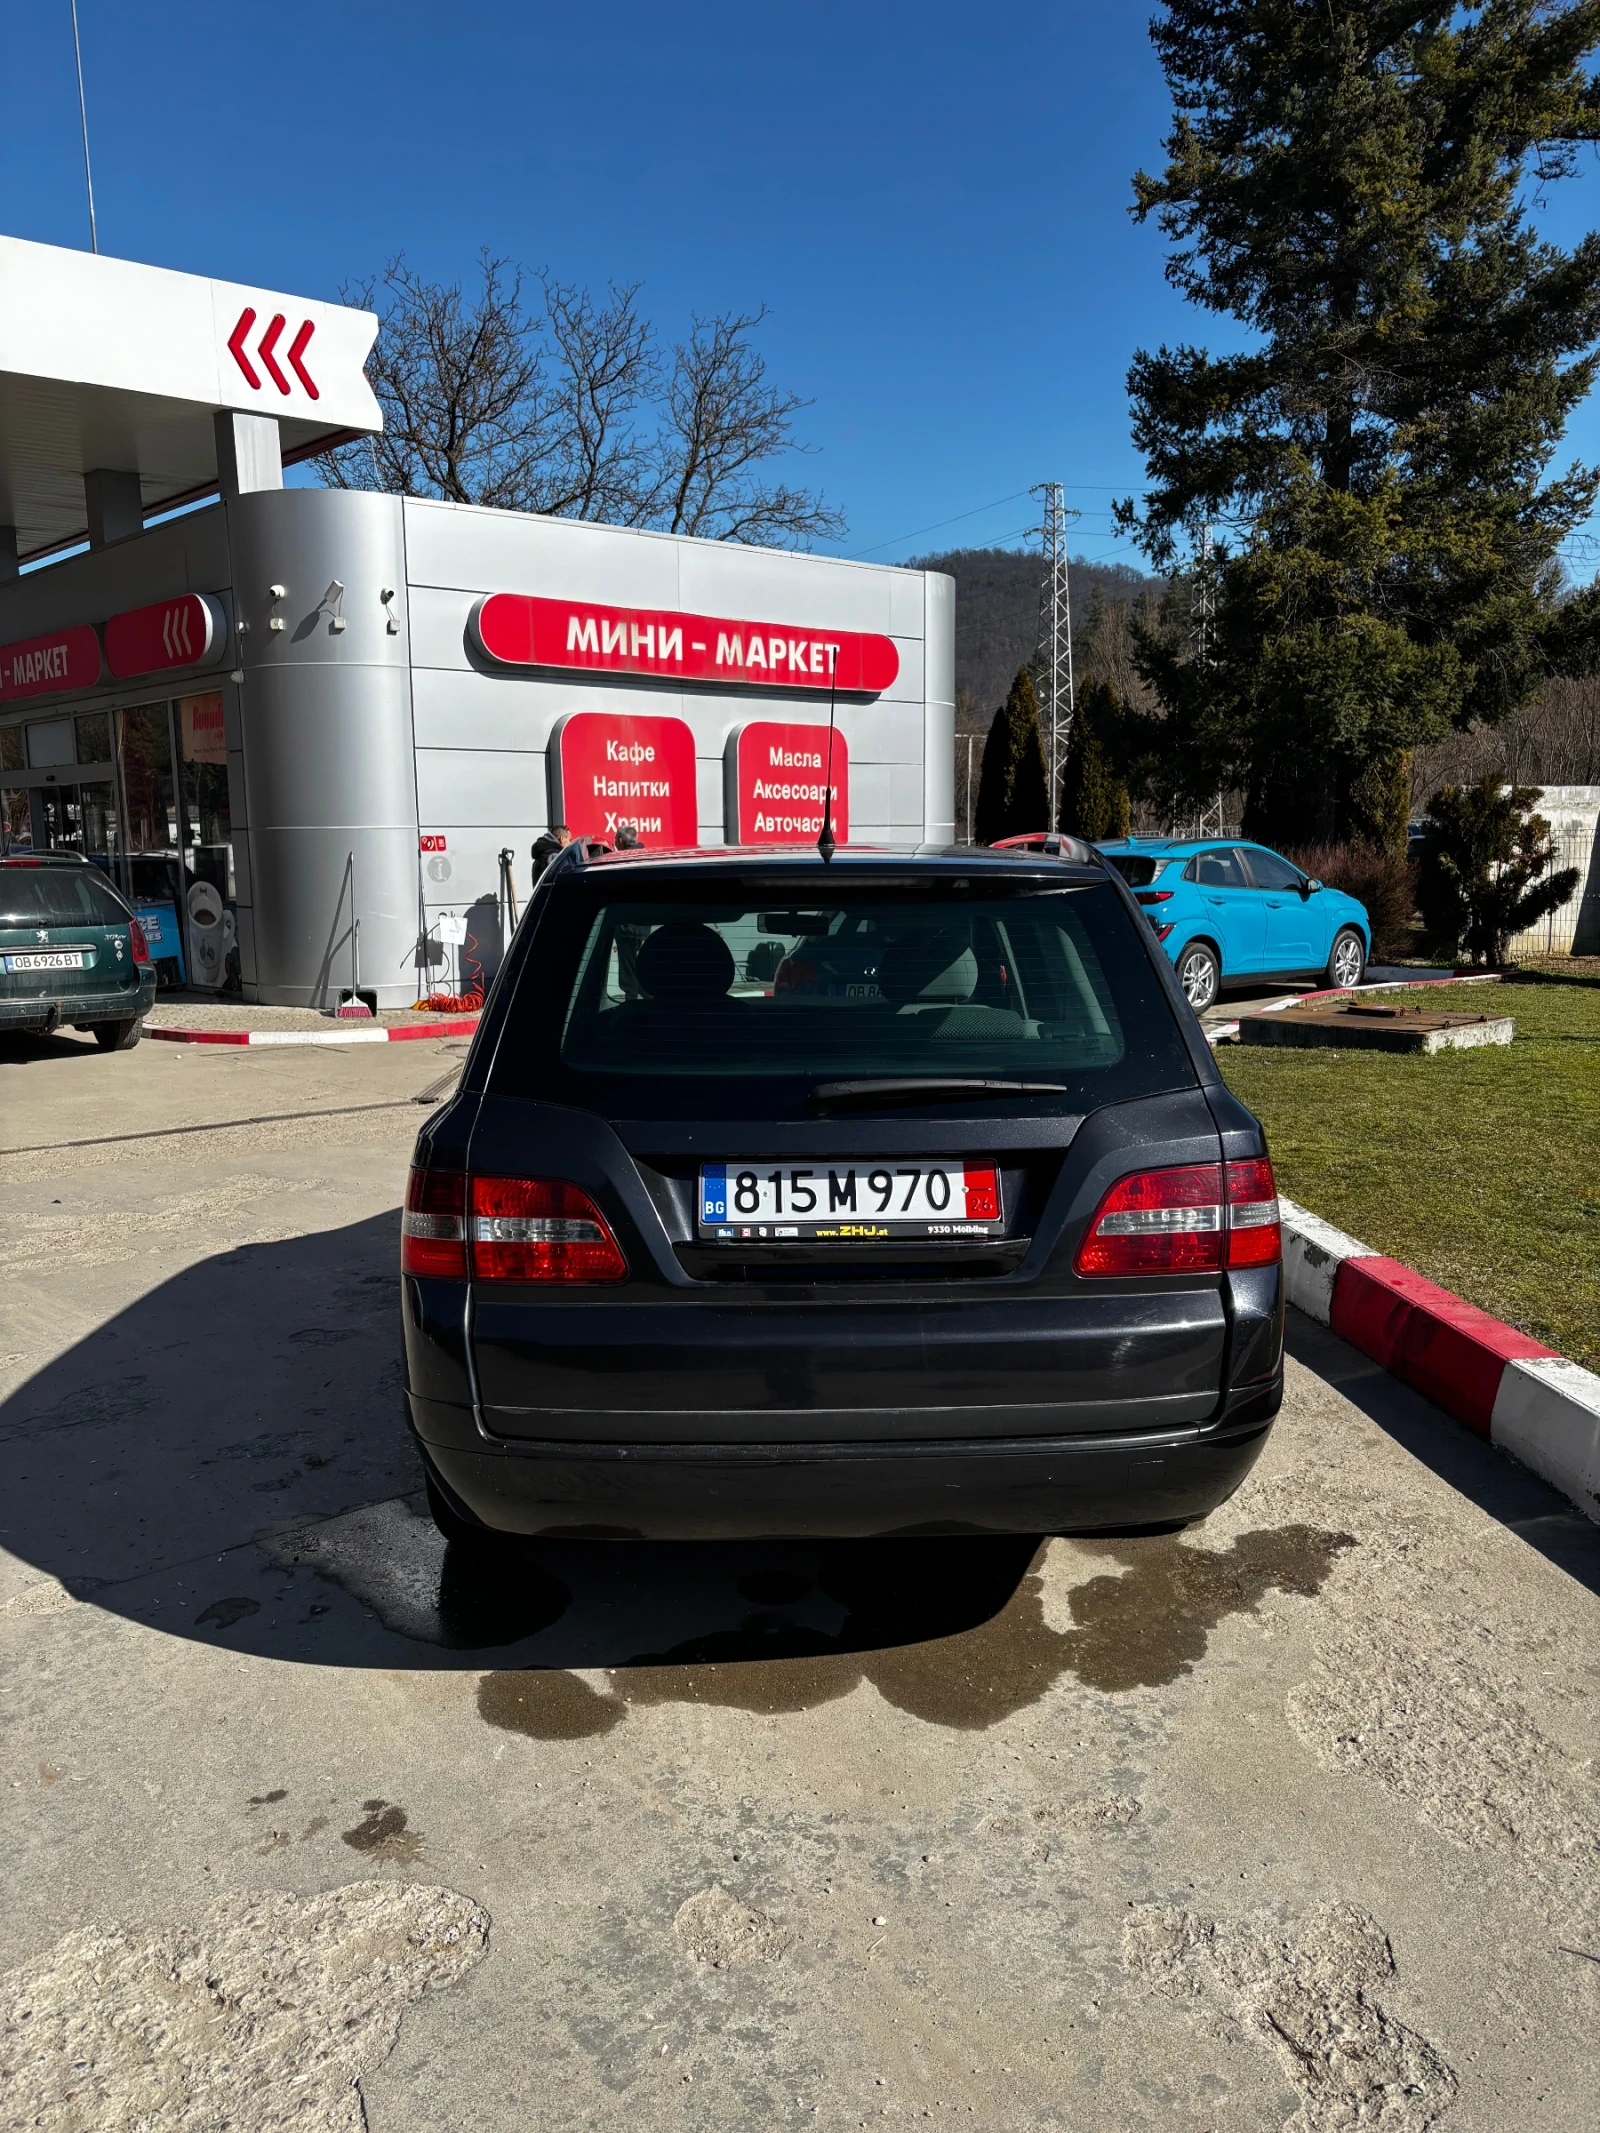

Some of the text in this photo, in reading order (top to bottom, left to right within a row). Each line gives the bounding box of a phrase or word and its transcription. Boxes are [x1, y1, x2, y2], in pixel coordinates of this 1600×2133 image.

[566, 616, 683, 661] МИНИ
[716, 632, 840, 674] МАРКЕТ
[13, 645, 68, 686] МАРКЕТ
[606, 740, 655, 766] Кафе
[769, 746, 822, 768] Масла
[593, 775, 670, 797] Напитки
[753, 778, 838, 805] Аксесоари
[15, 954, 79, 968] OB 6926 BT
[705, 1169, 993, 1214] BG 815 M 970 26
[816, 1226, 888, 1237] www.ZHJ.at
[927, 1225, 951, 1234] 9330
